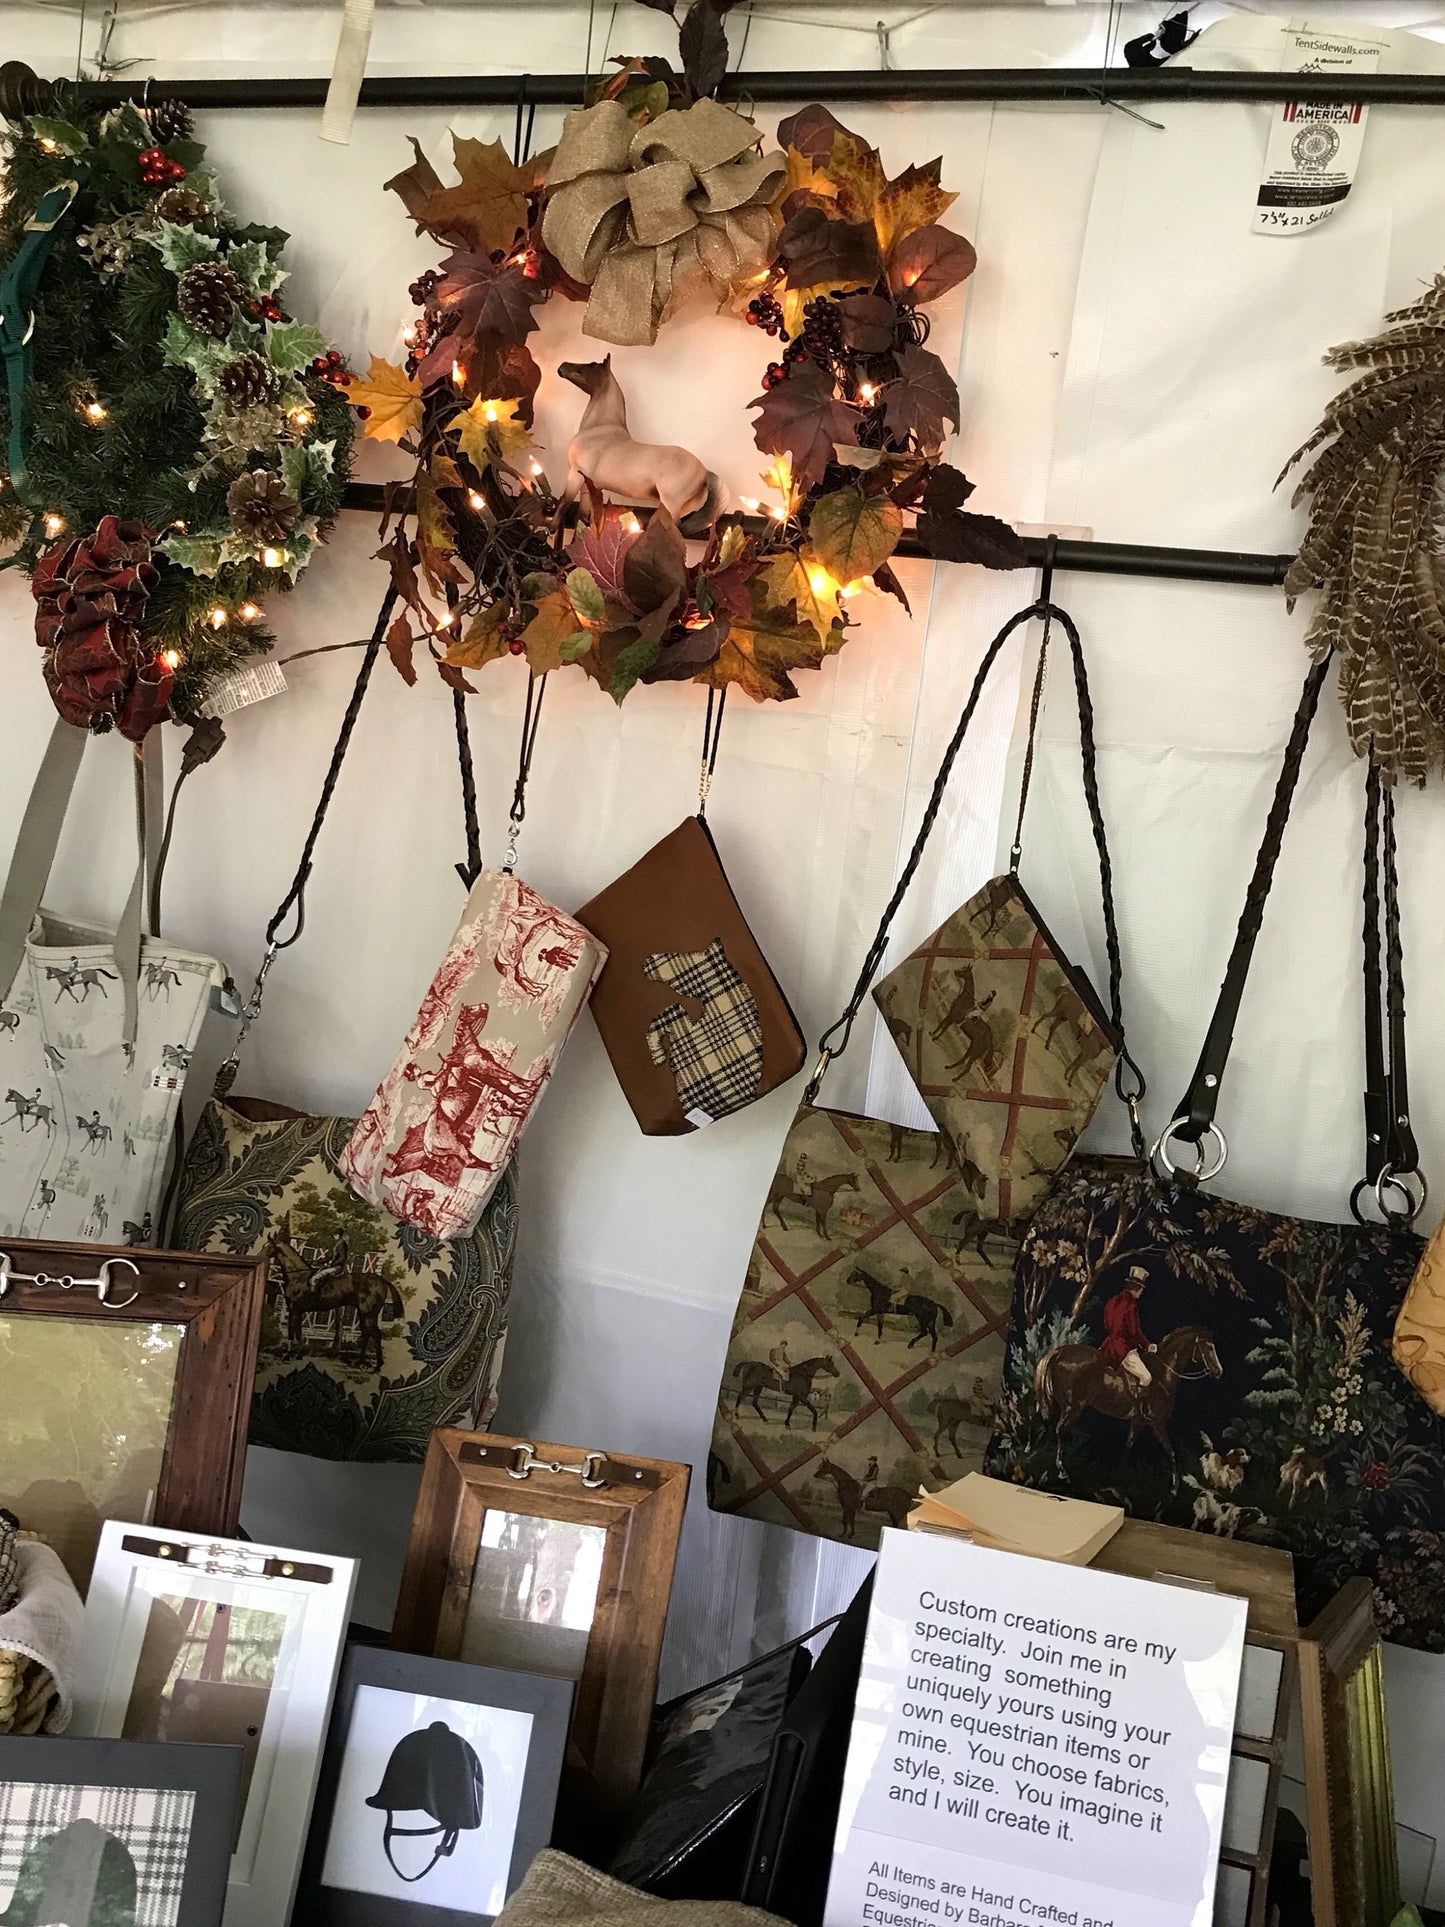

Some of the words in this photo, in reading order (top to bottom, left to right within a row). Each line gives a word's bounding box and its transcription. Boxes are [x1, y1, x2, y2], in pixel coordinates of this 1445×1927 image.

[1295, 37, 1380, 55] TentSidewalls.com
[1296, 108, 1349, 120] AMERICA
[1306, 101, 1331, 109] MADE
[914, 1621, 1007, 1657] specialty.
[1020, 1640, 1063, 1666] Join
[1069, 1654, 1103, 1674] me
[1108, 1657, 1127, 1680] in
[919, 1590, 997, 1624] Custom
[1003, 1612, 1098, 1645] creations
[1103, 1633, 1138, 1654] are
[1144, 1641, 1178, 1666] my
[910, 1648, 992, 1683] creating
[1003, 1668, 1112, 1709] something
[901, 1702, 944, 1725] own
[950, 1713, 1059, 1751] equestrian
[1064, 1735, 1122, 1765] items
[1127, 1753, 1152, 1771] or
[906, 1675, 993, 1711] uniquely
[996, 1695, 1055, 1721] yours
[1061, 1709, 1118, 1739] using
[1122, 1722, 1172, 1746] your
[892, 1756, 945, 1785] style,
[952, 1768, 1000, 1795] size.
[1014, 1779, 1054, 1807] You
[1059, 1790, 1144, 1828] imagine
[1150, 1811, 1163, 1834] it
[897, 1729, 952, 1756] mine.
[967, 1740, 1006, 1767] You
[1011, 1753, 1088, 1786] choose
[1094, 1769, 1170, 1808] fabrics,
[888, 1785, 928, 1807] and
[933, 1790, 941, 1810] I
[946, 1797, 980, 1819] will
[984, 1807, 1051, 1836] create
[1056, 1819, 1074, 1842] it.
[865, 1881, 941, 1914] Designed
[944, 1901, 965, 1923] by
[867, 1860, 890, 1879] All
[893, 1865, 936, 1891] Items
[940, 1881, 967, 1898] are
[971, 1885, 1015, 1910] Hand
[1018, 1898, 1079, 1926] Crafted
[1082, 1917, 1114, 1927] and
